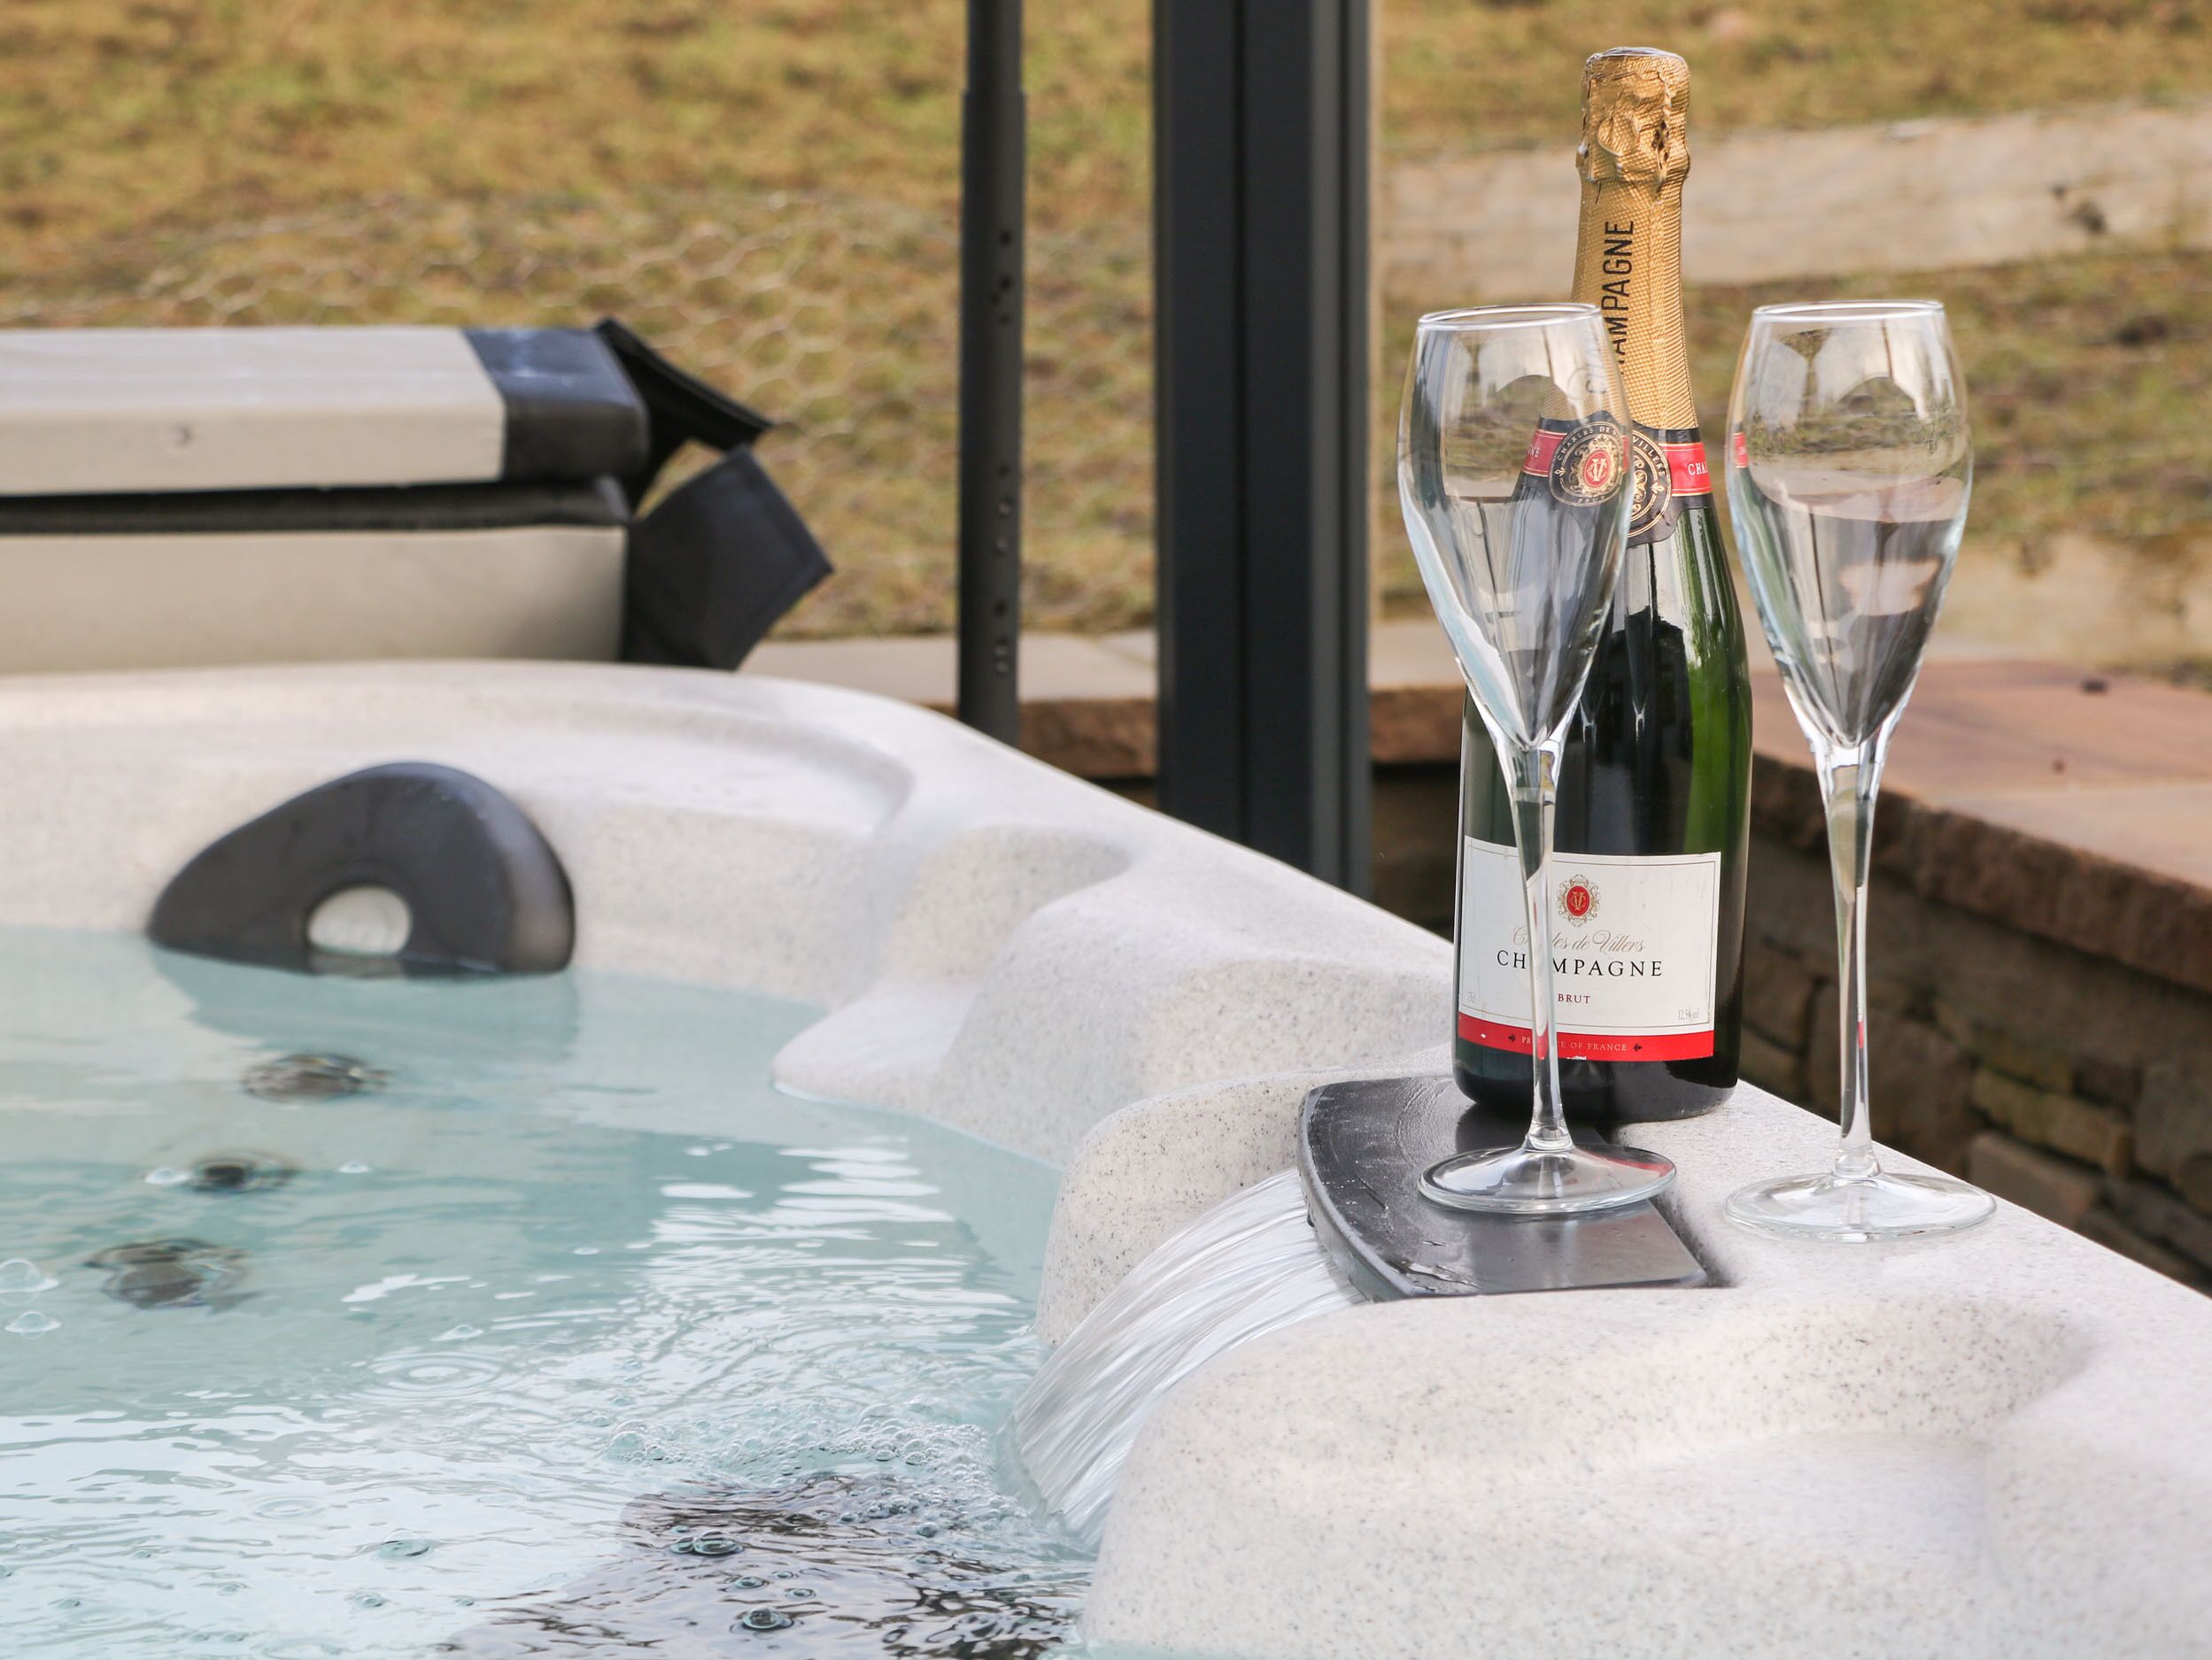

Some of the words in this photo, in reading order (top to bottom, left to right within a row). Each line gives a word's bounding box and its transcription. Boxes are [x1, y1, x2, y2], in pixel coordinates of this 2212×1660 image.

[1600, 221, 1634, 375] AMPAGNE
[1557, 428, 1594, 461] CHARLES
[1633, 436, 1667, 476] VILLERS
[1512, 925, 1567, 950] Cles
[1572, 935, 1591, 951] de
[1593, 930, 1644, 953] Villers
[1497, 949, 1662, 977] CHMPAGNE
[1558, 993, 1591, 1004] BRUT
